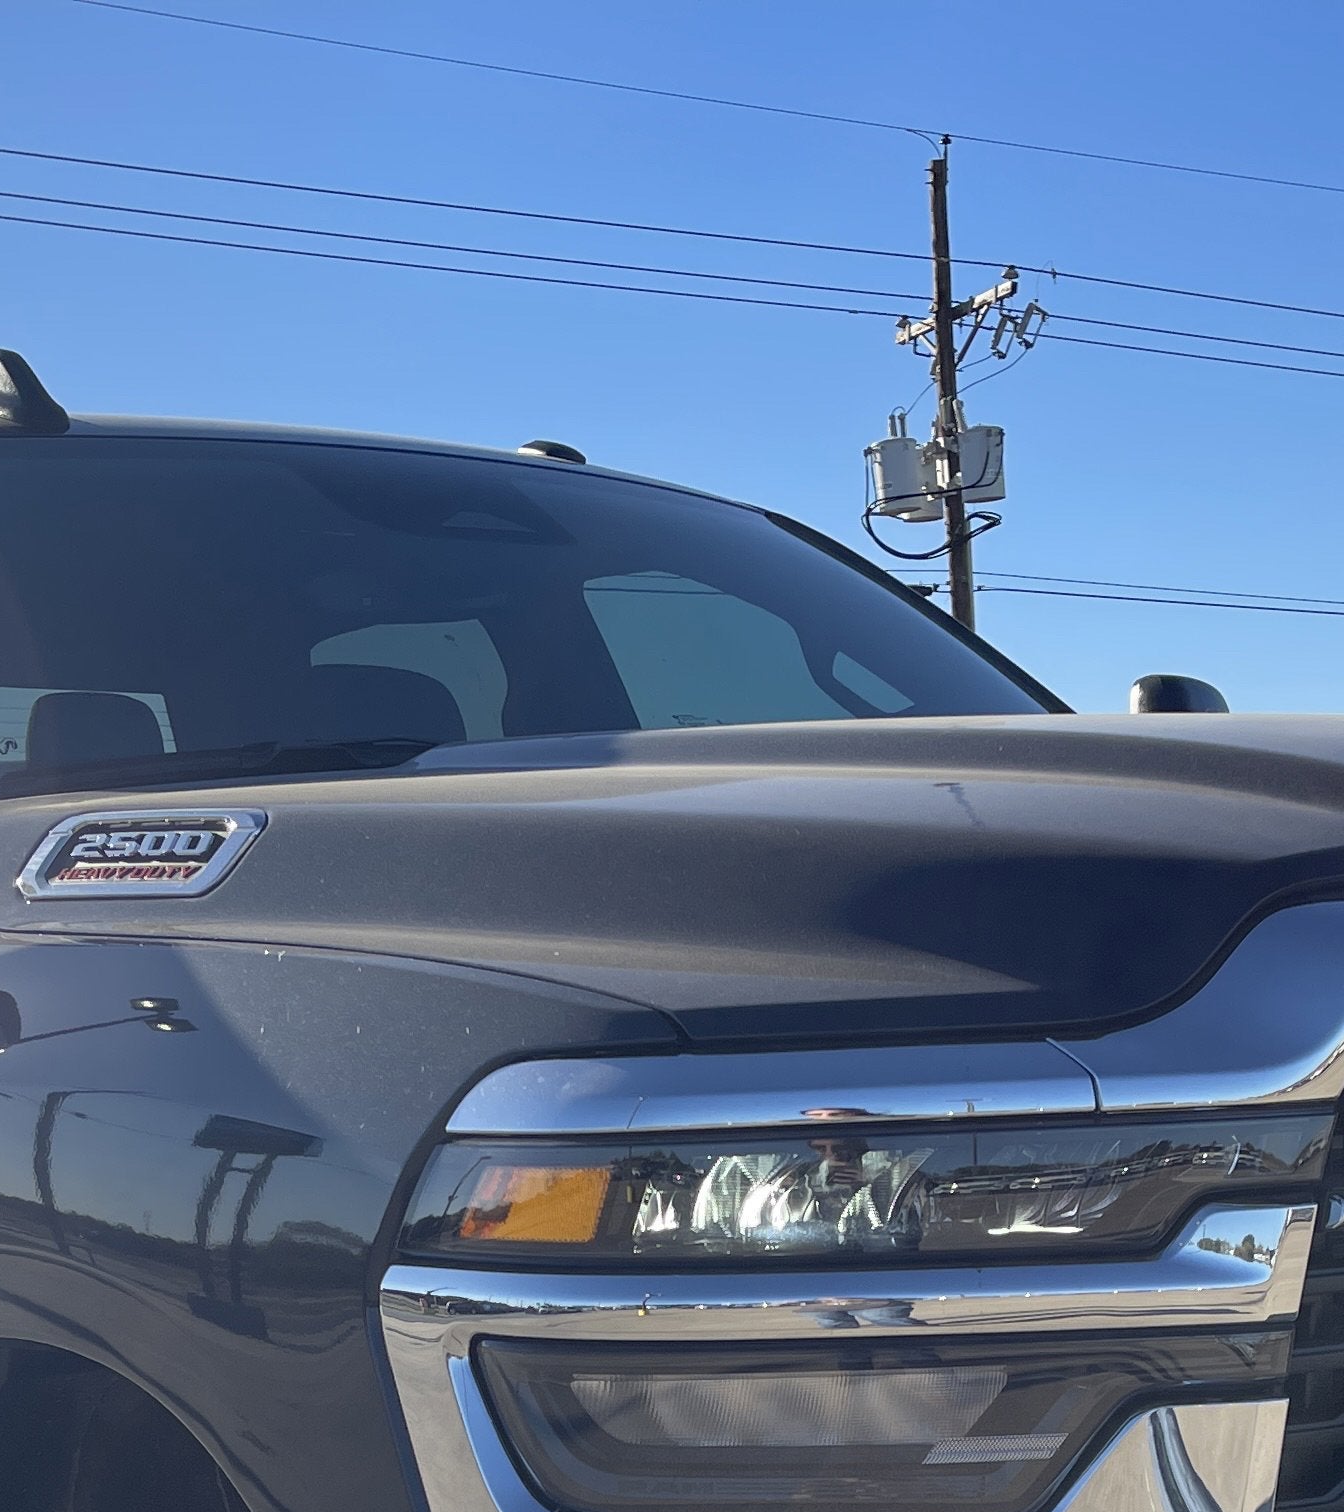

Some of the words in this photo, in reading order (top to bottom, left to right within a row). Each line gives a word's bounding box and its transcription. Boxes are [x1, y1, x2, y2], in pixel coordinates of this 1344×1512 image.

[69, 830, 217, 859] 2500
[57, 866, 132, 881] HEAVY
[129, 865, 203, 880] DUTY
